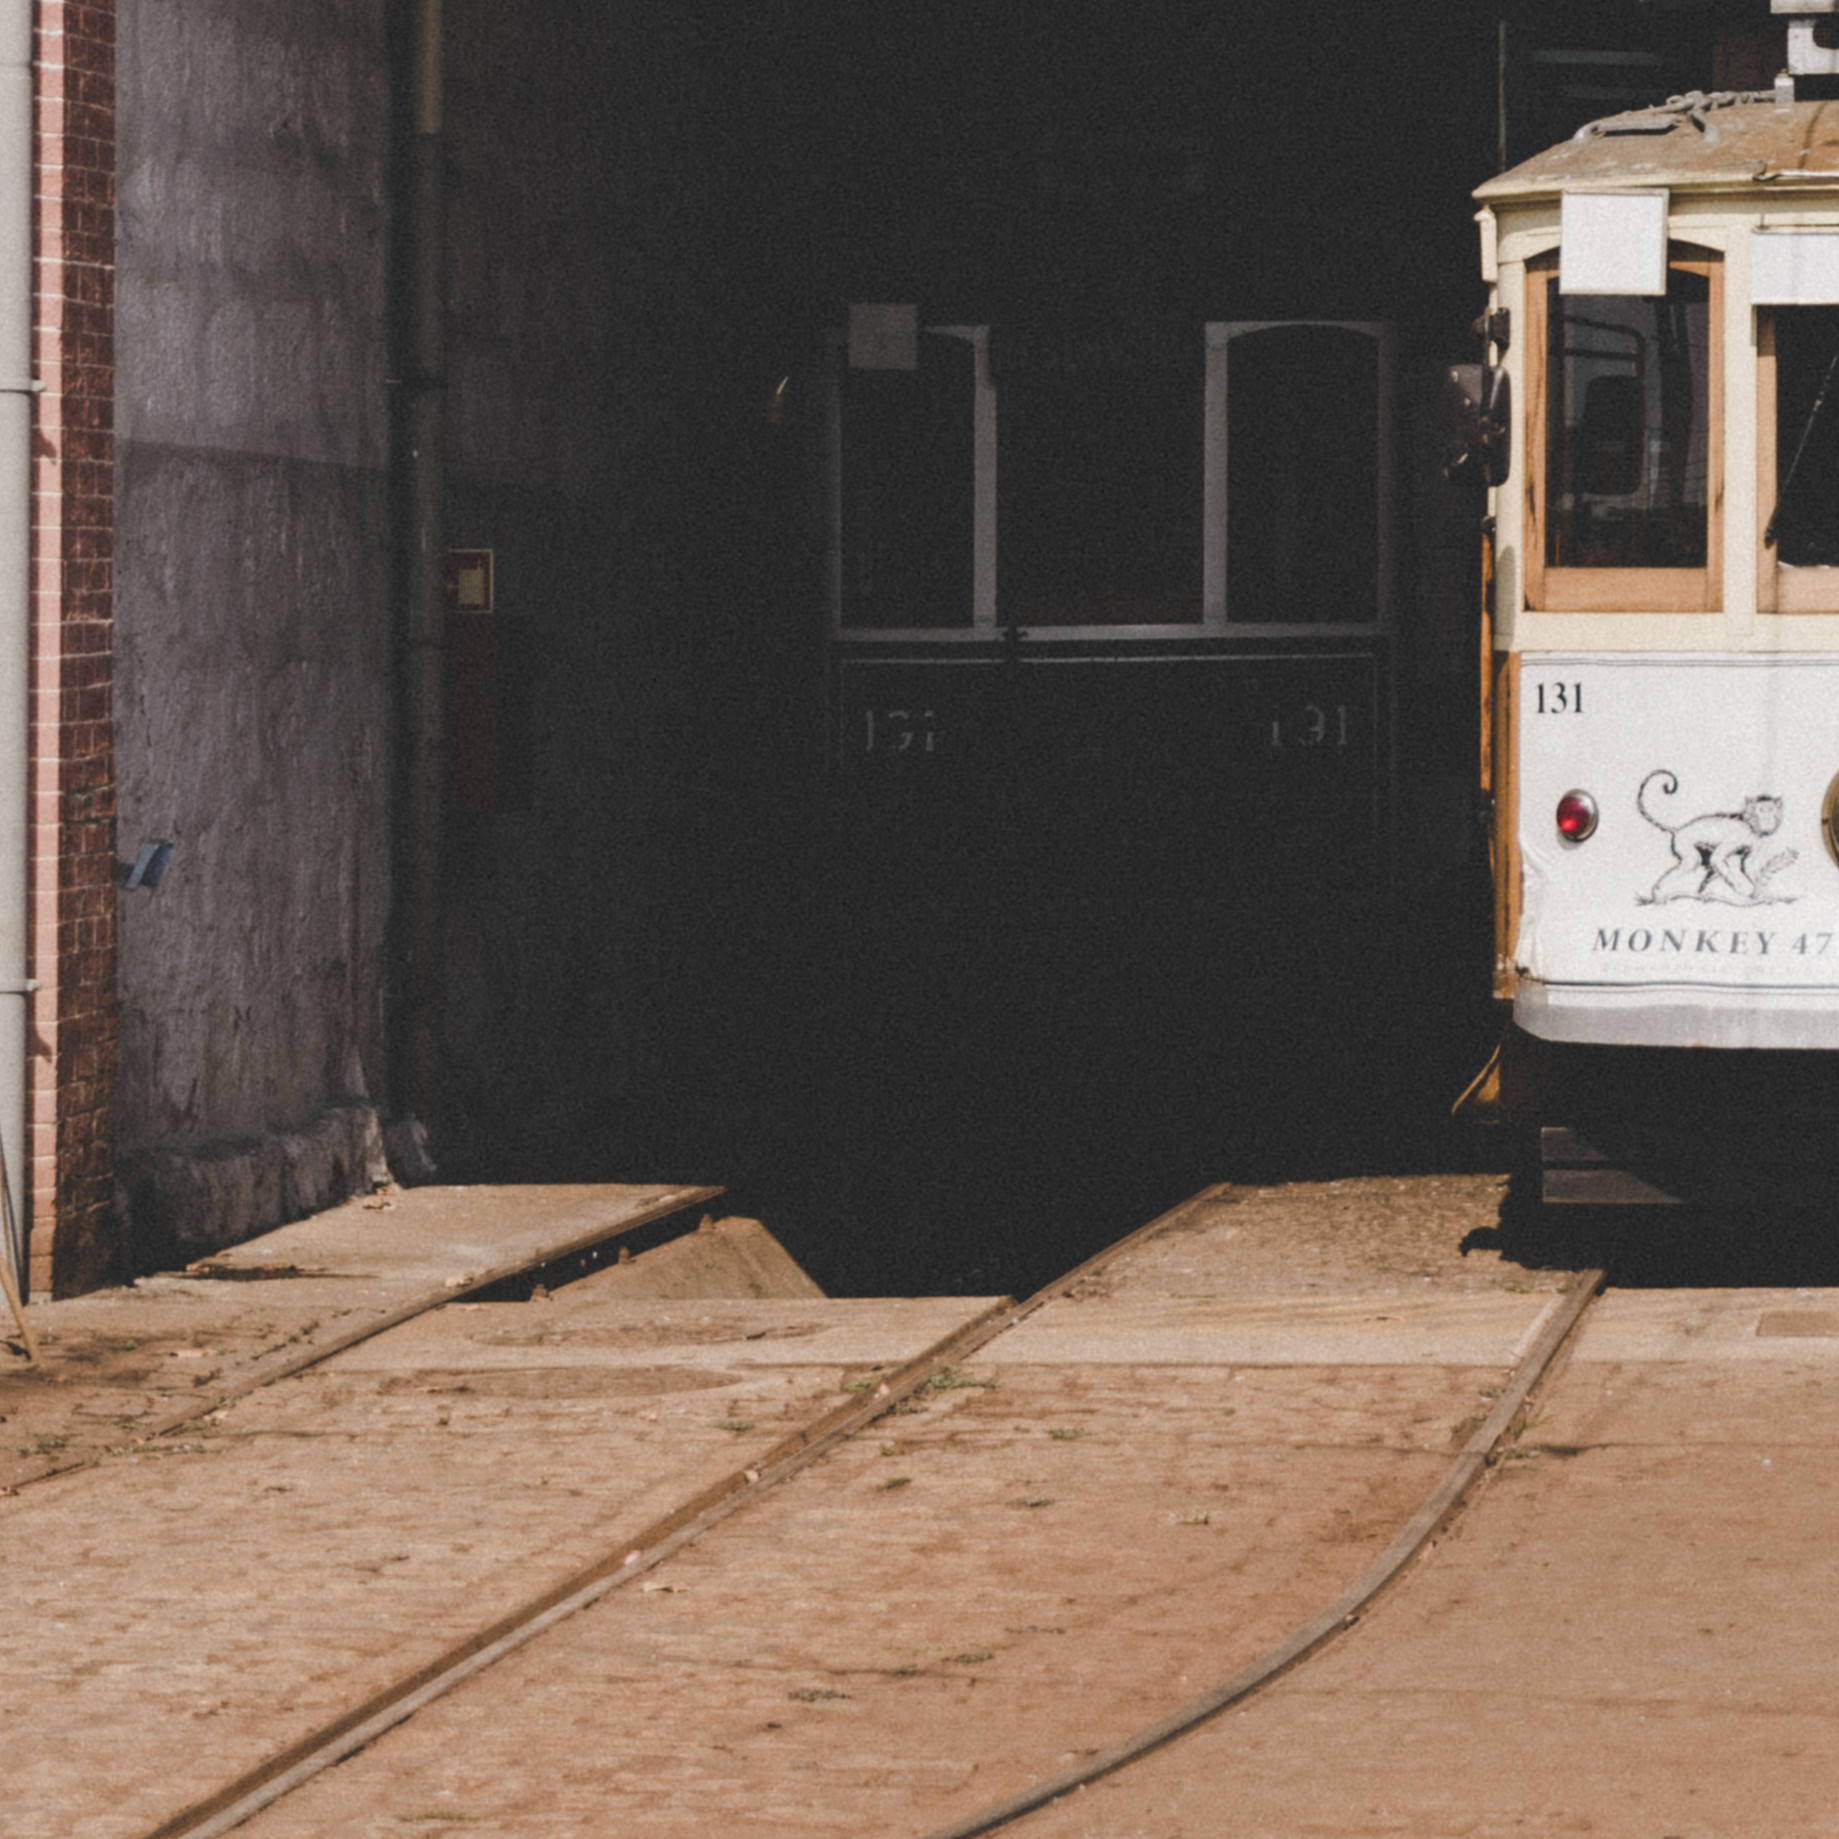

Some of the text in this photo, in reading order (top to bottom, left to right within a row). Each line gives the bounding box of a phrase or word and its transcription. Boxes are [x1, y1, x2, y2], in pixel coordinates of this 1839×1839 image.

[1535, 681, 1585, 715] 131
[1592, 927, 1835, 956] MONKEY 47
